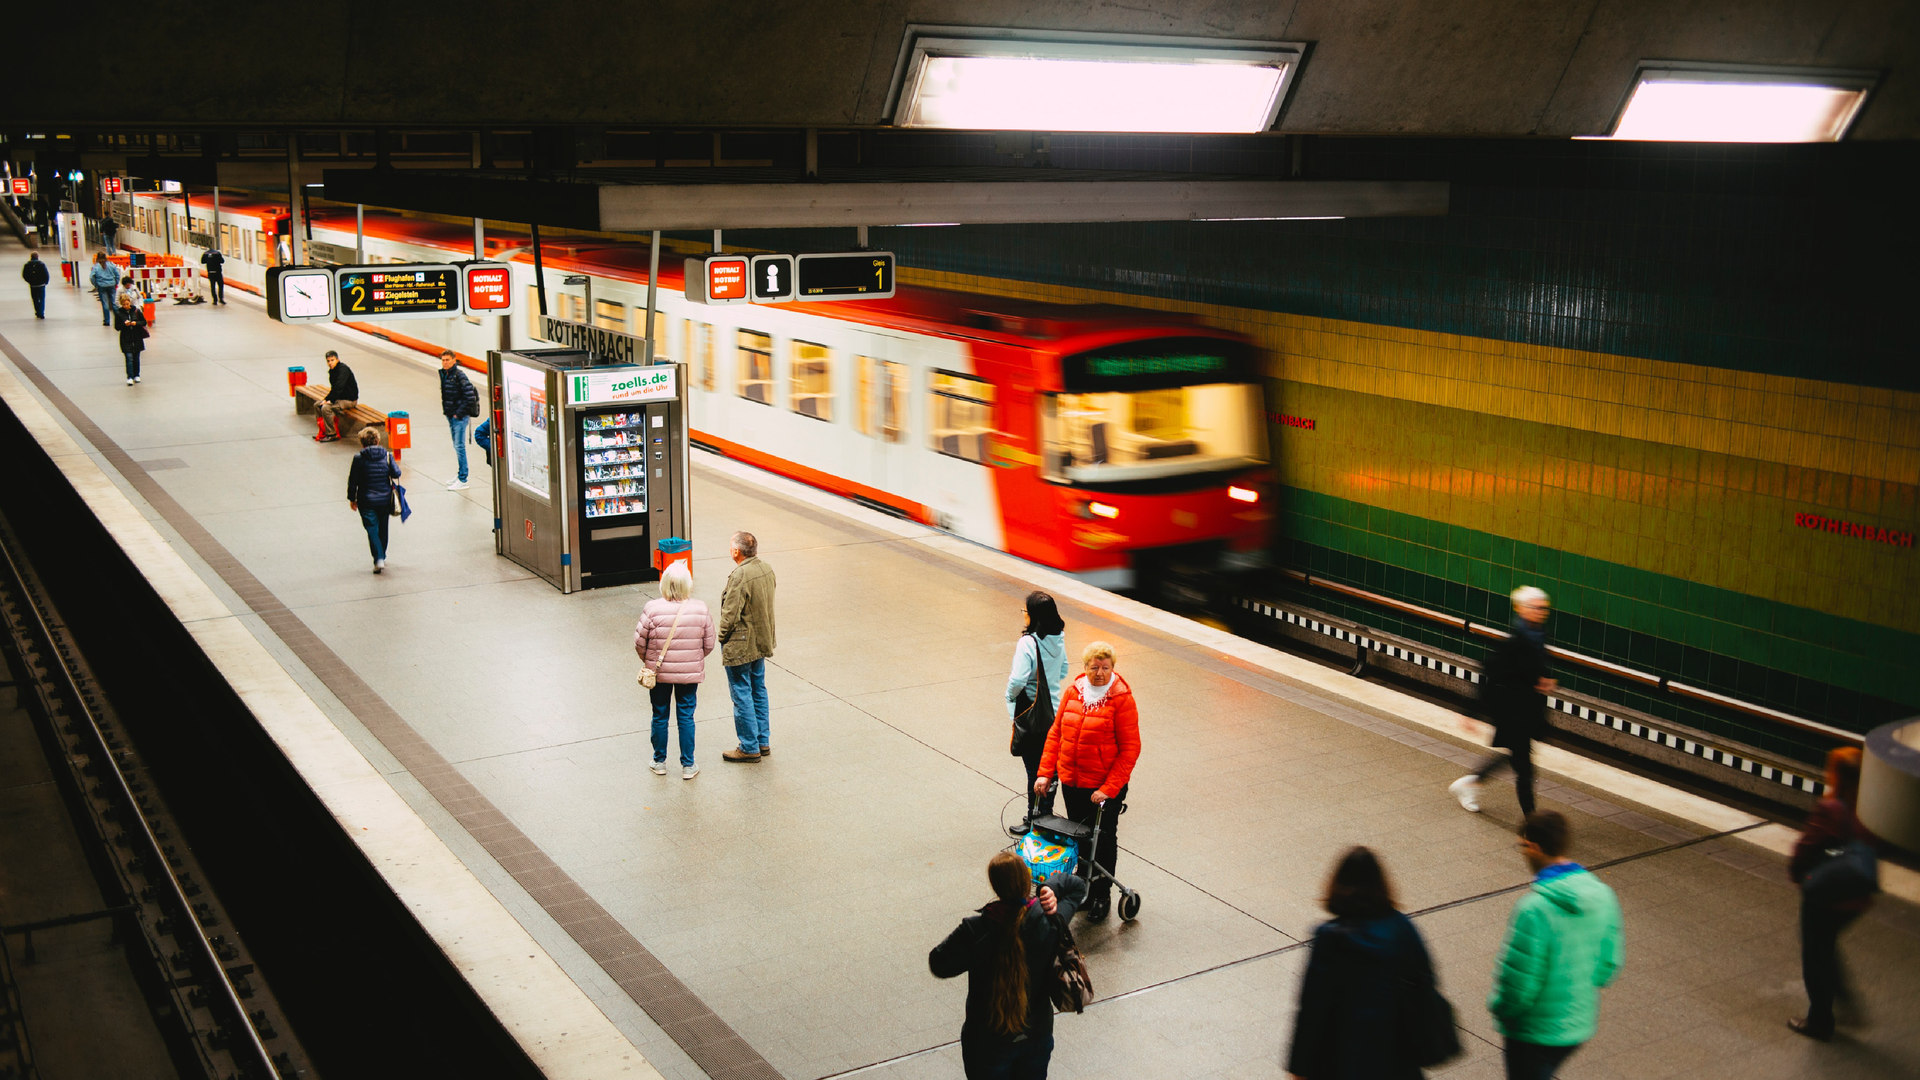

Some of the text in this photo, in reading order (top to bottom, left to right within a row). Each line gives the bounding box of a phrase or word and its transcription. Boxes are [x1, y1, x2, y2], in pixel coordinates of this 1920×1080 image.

[872, 259, 886, 267] Gleis
[349, 276, 365, 285] Gleis
[373, 273, 415, 283] U2 Flughafen
[473, 274, 503, 283] NOTHALT
[714, 276, 740, 284] NOTRUF
[875, 267, 883, 290] 1
[440, 289, 446, 297] 9
[473, 284, 503, 293] NOTRUF
[351, 286, 366, 311] 2
[374, 290, 419, 300] U2 Ziegelstein
[547, 317, 634, 363] RÖTHENBACH
[611, 373, 668, 392] zoells.de
[612, 390, 629, 400] rund
[655, 384, 669, 392] Uhr
[1257, 410, 1314, 430] THENBACH
[1795, 512, 1913, 548] RÖTHENBACH
